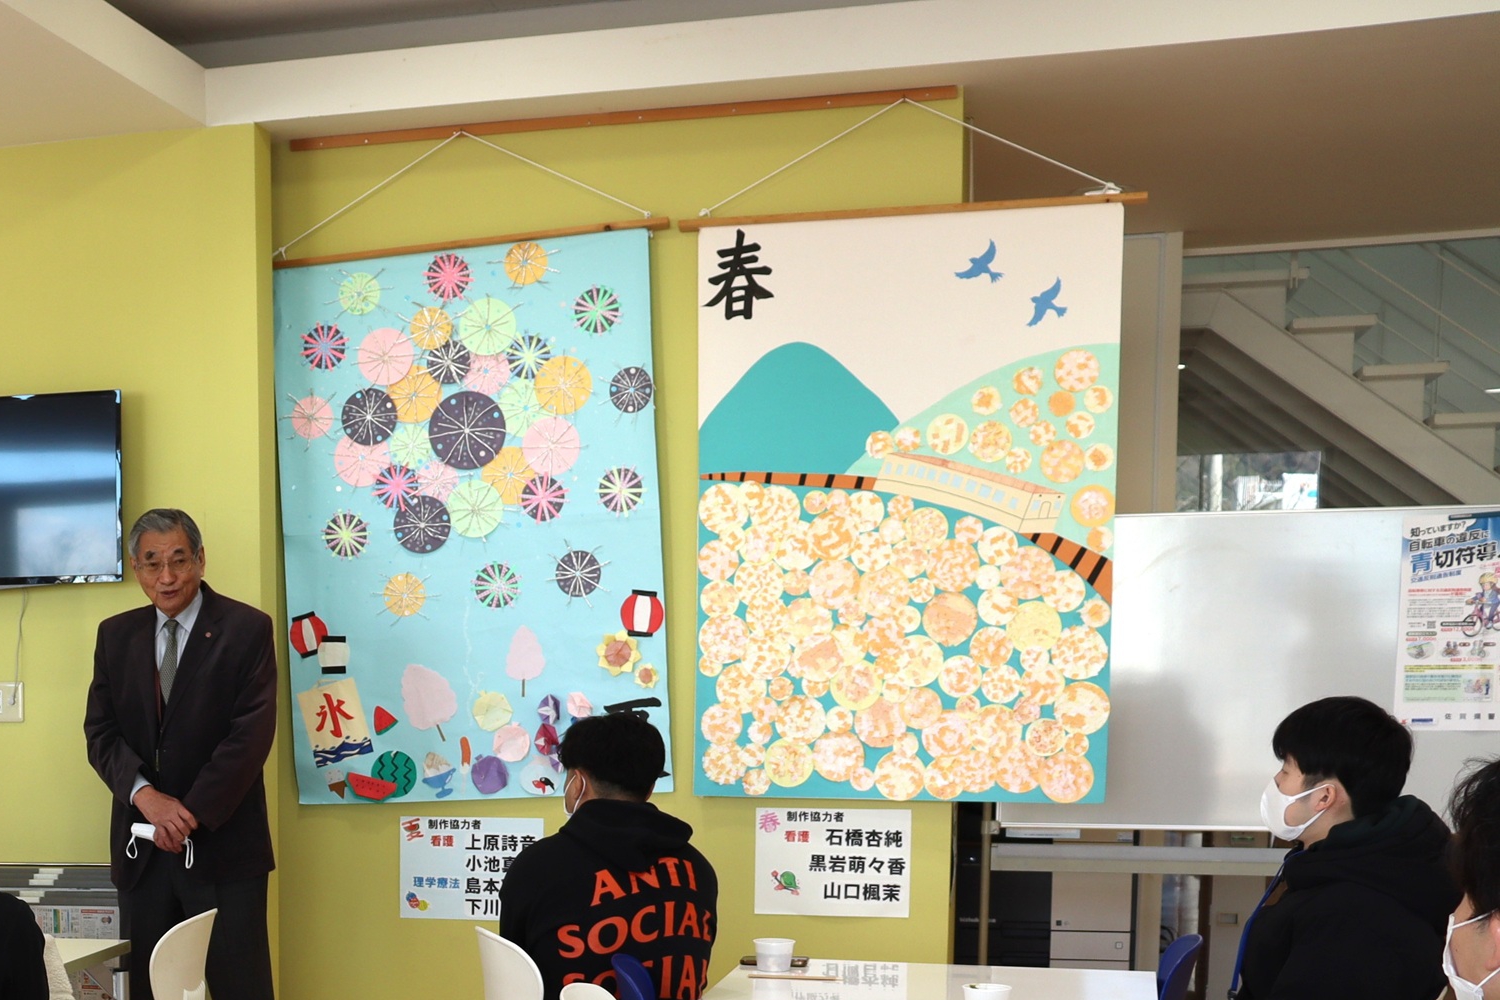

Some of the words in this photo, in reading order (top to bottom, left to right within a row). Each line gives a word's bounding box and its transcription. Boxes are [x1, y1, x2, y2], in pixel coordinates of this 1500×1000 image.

[701, 228, 775, 321] 春
[1410, 542, 1500, 574] 青切符導
[315, 692, 354, 738] 氷
[428, 819, 482, 830] 制作協力者
[787, 811, 844, 822] 制作協力者
[431, 835, 454, 847] 看護
[784, 830, 810, 843] 看護
[825, 828, 903, 848] 石橋杏純
[808, 854, 906, 876] 黒岩萌々香
[413, 876, 460, 889] 理学療法
[590, 857, 698, 907] ANTI
[823, 882, 901, 903] 山口楓茉
[557, 901, 711, 959] SOCIAL
